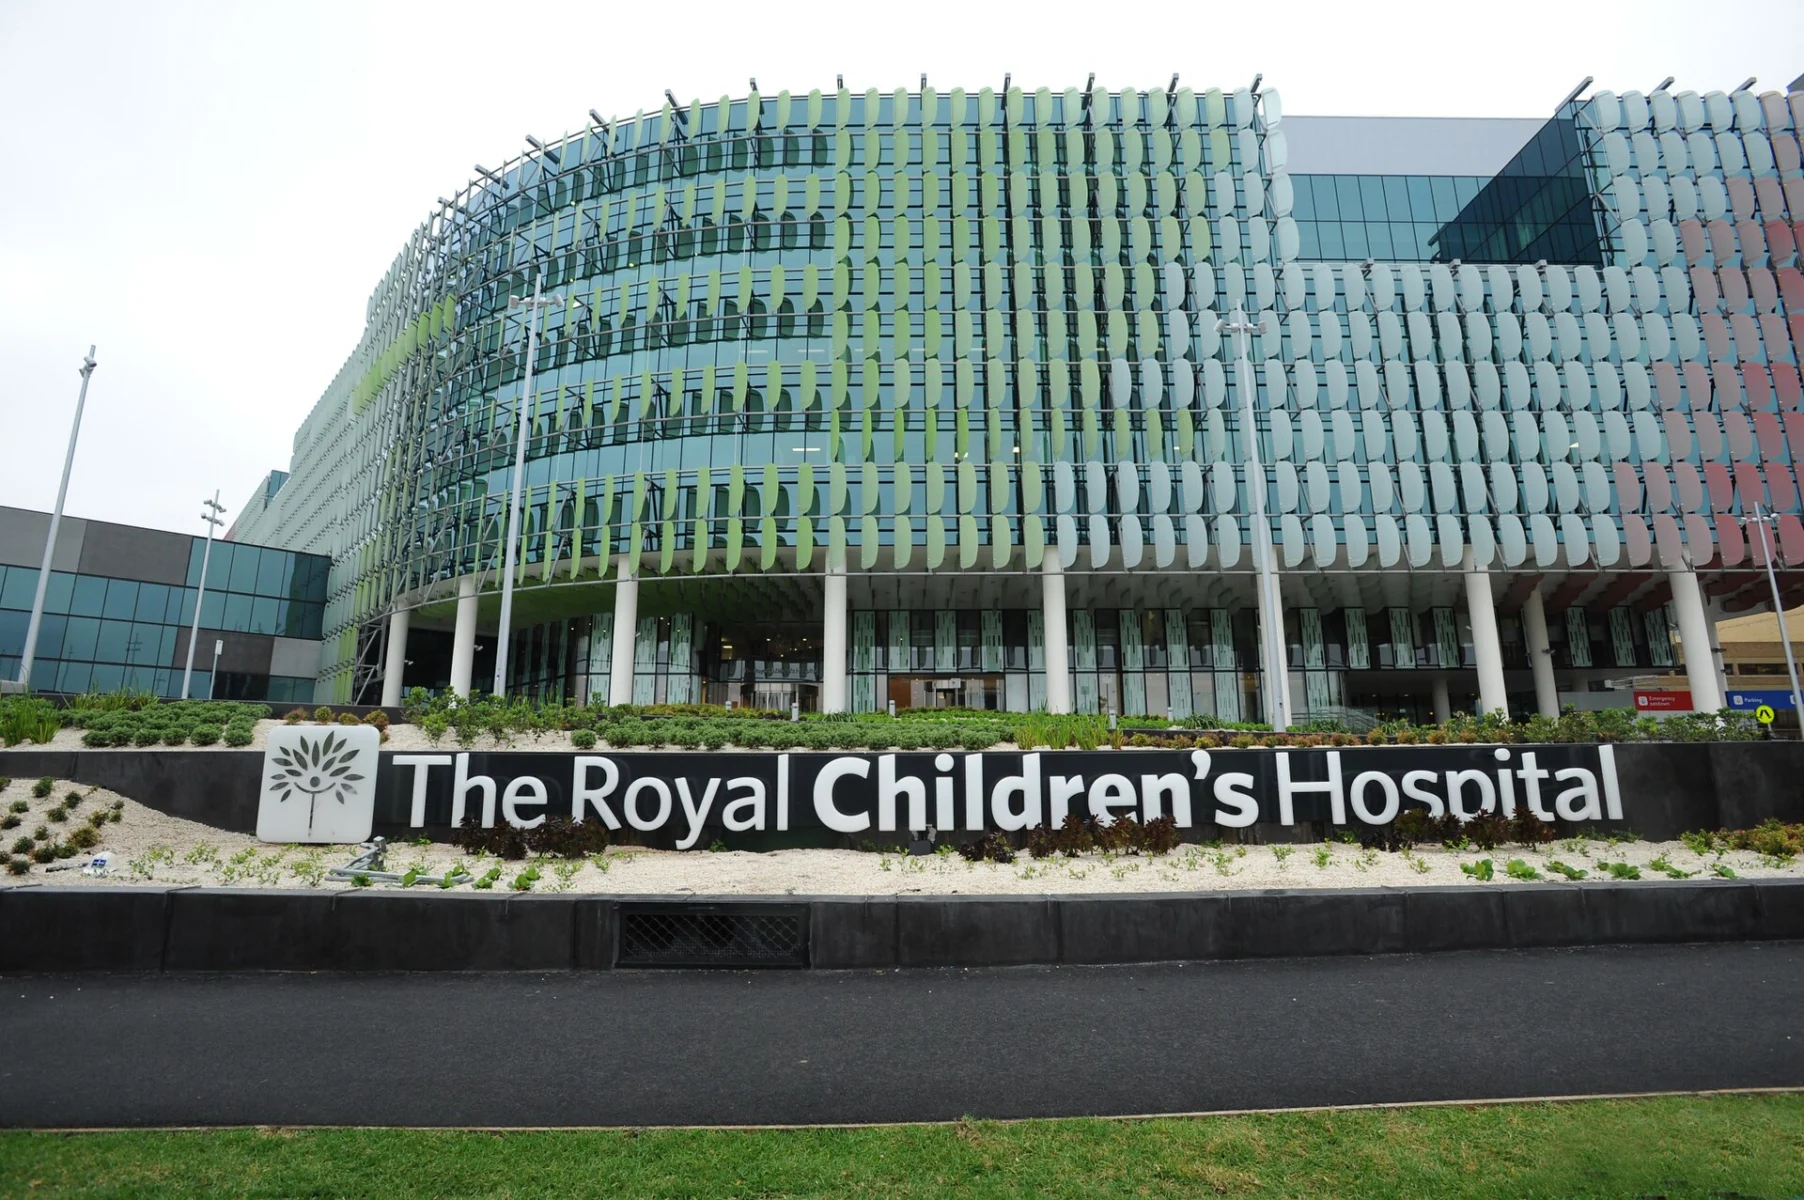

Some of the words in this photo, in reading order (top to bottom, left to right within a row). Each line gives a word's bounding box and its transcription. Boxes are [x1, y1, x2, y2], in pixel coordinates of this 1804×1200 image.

[392, 752, 548, 830] The
[571, 753, 790, 850] Royal
[1275, 743, 1625, 827] Hospital
